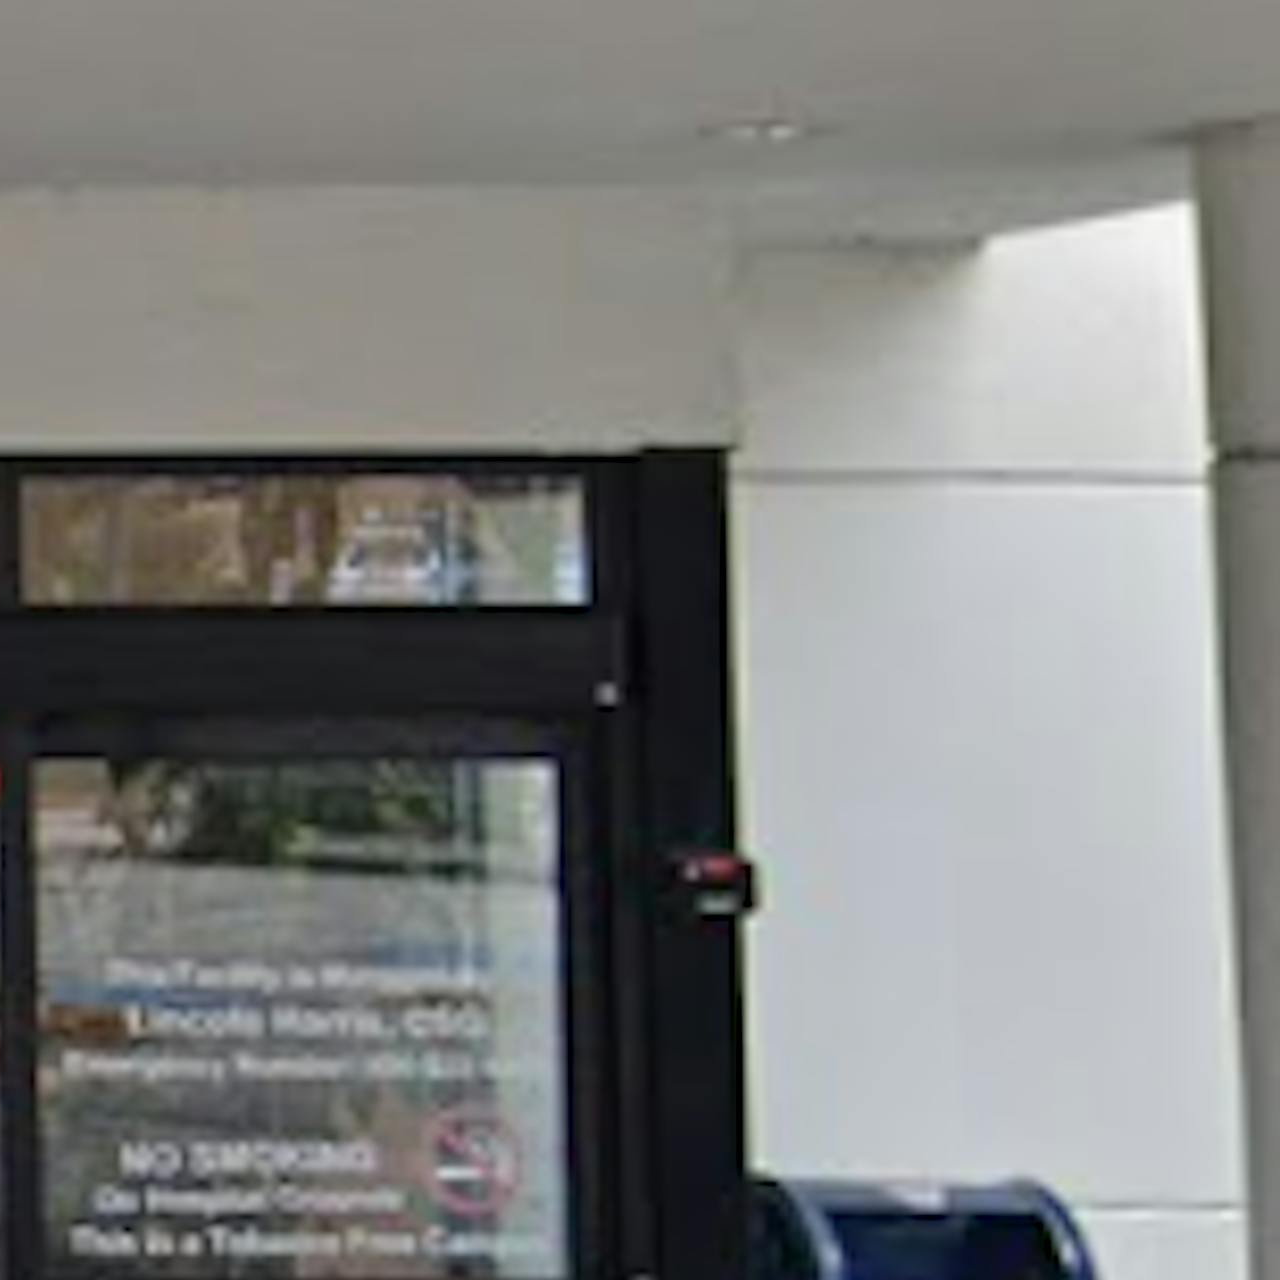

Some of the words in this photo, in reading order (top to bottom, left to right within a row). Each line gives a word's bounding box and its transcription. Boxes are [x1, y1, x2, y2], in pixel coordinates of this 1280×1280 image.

[125, 1004, 264, 1039] Lincoln
[118, 1140, 183, 1180] NO
[190, 1138, 378, 1179] SMOKING
[69, 1222, 139, 1257] This
[144, 1222, 176, 1257] is
[180, 1229, 204, 1257] a
